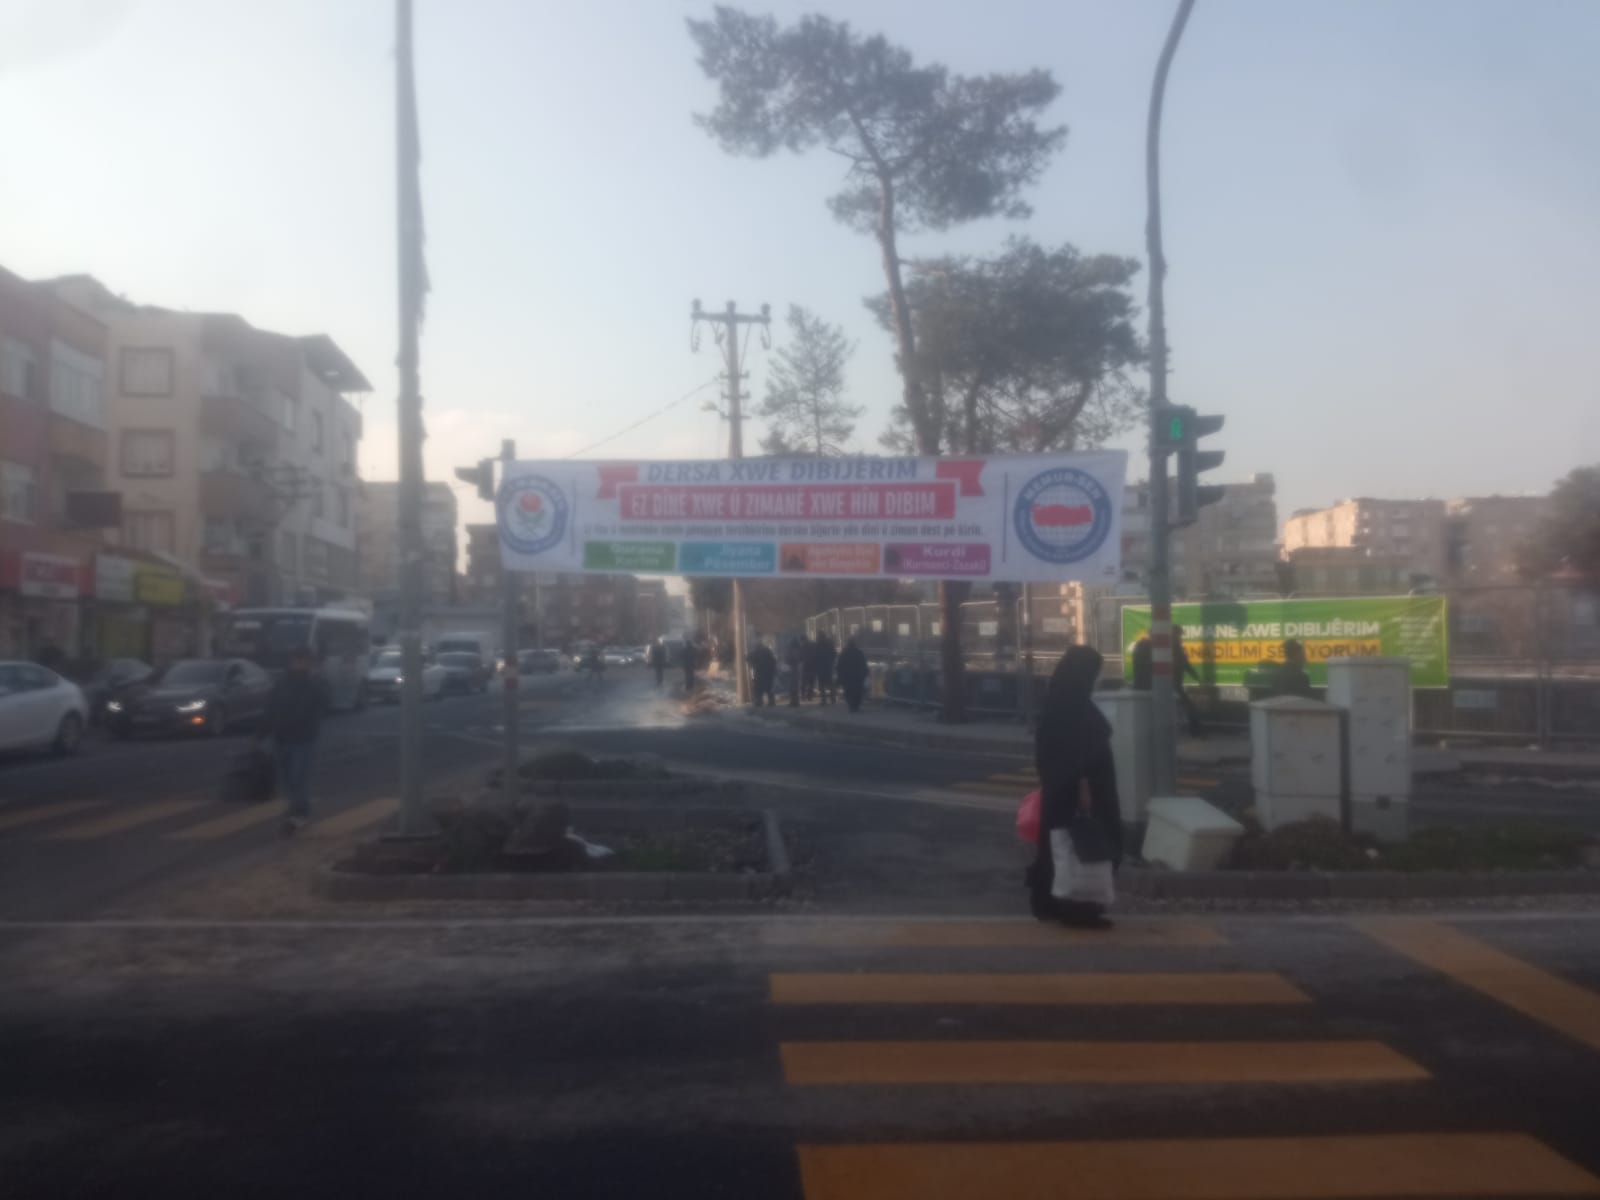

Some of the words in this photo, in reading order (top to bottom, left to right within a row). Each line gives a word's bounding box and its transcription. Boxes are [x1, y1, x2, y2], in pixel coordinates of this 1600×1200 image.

[646, 463, 721, 482] DERSA
[729, 463, 781, 482] XWE
[631, 493, 649, 516] EZ
[692, 493, 725, 516] XWE
[810, 492, 846, 516] XWE
[884, 490, 936, 515] DIBIM
[1284, 617, 1380, 636] DIBIJÊRIM
[1267, 645, 1377, 659] SEYORUM
